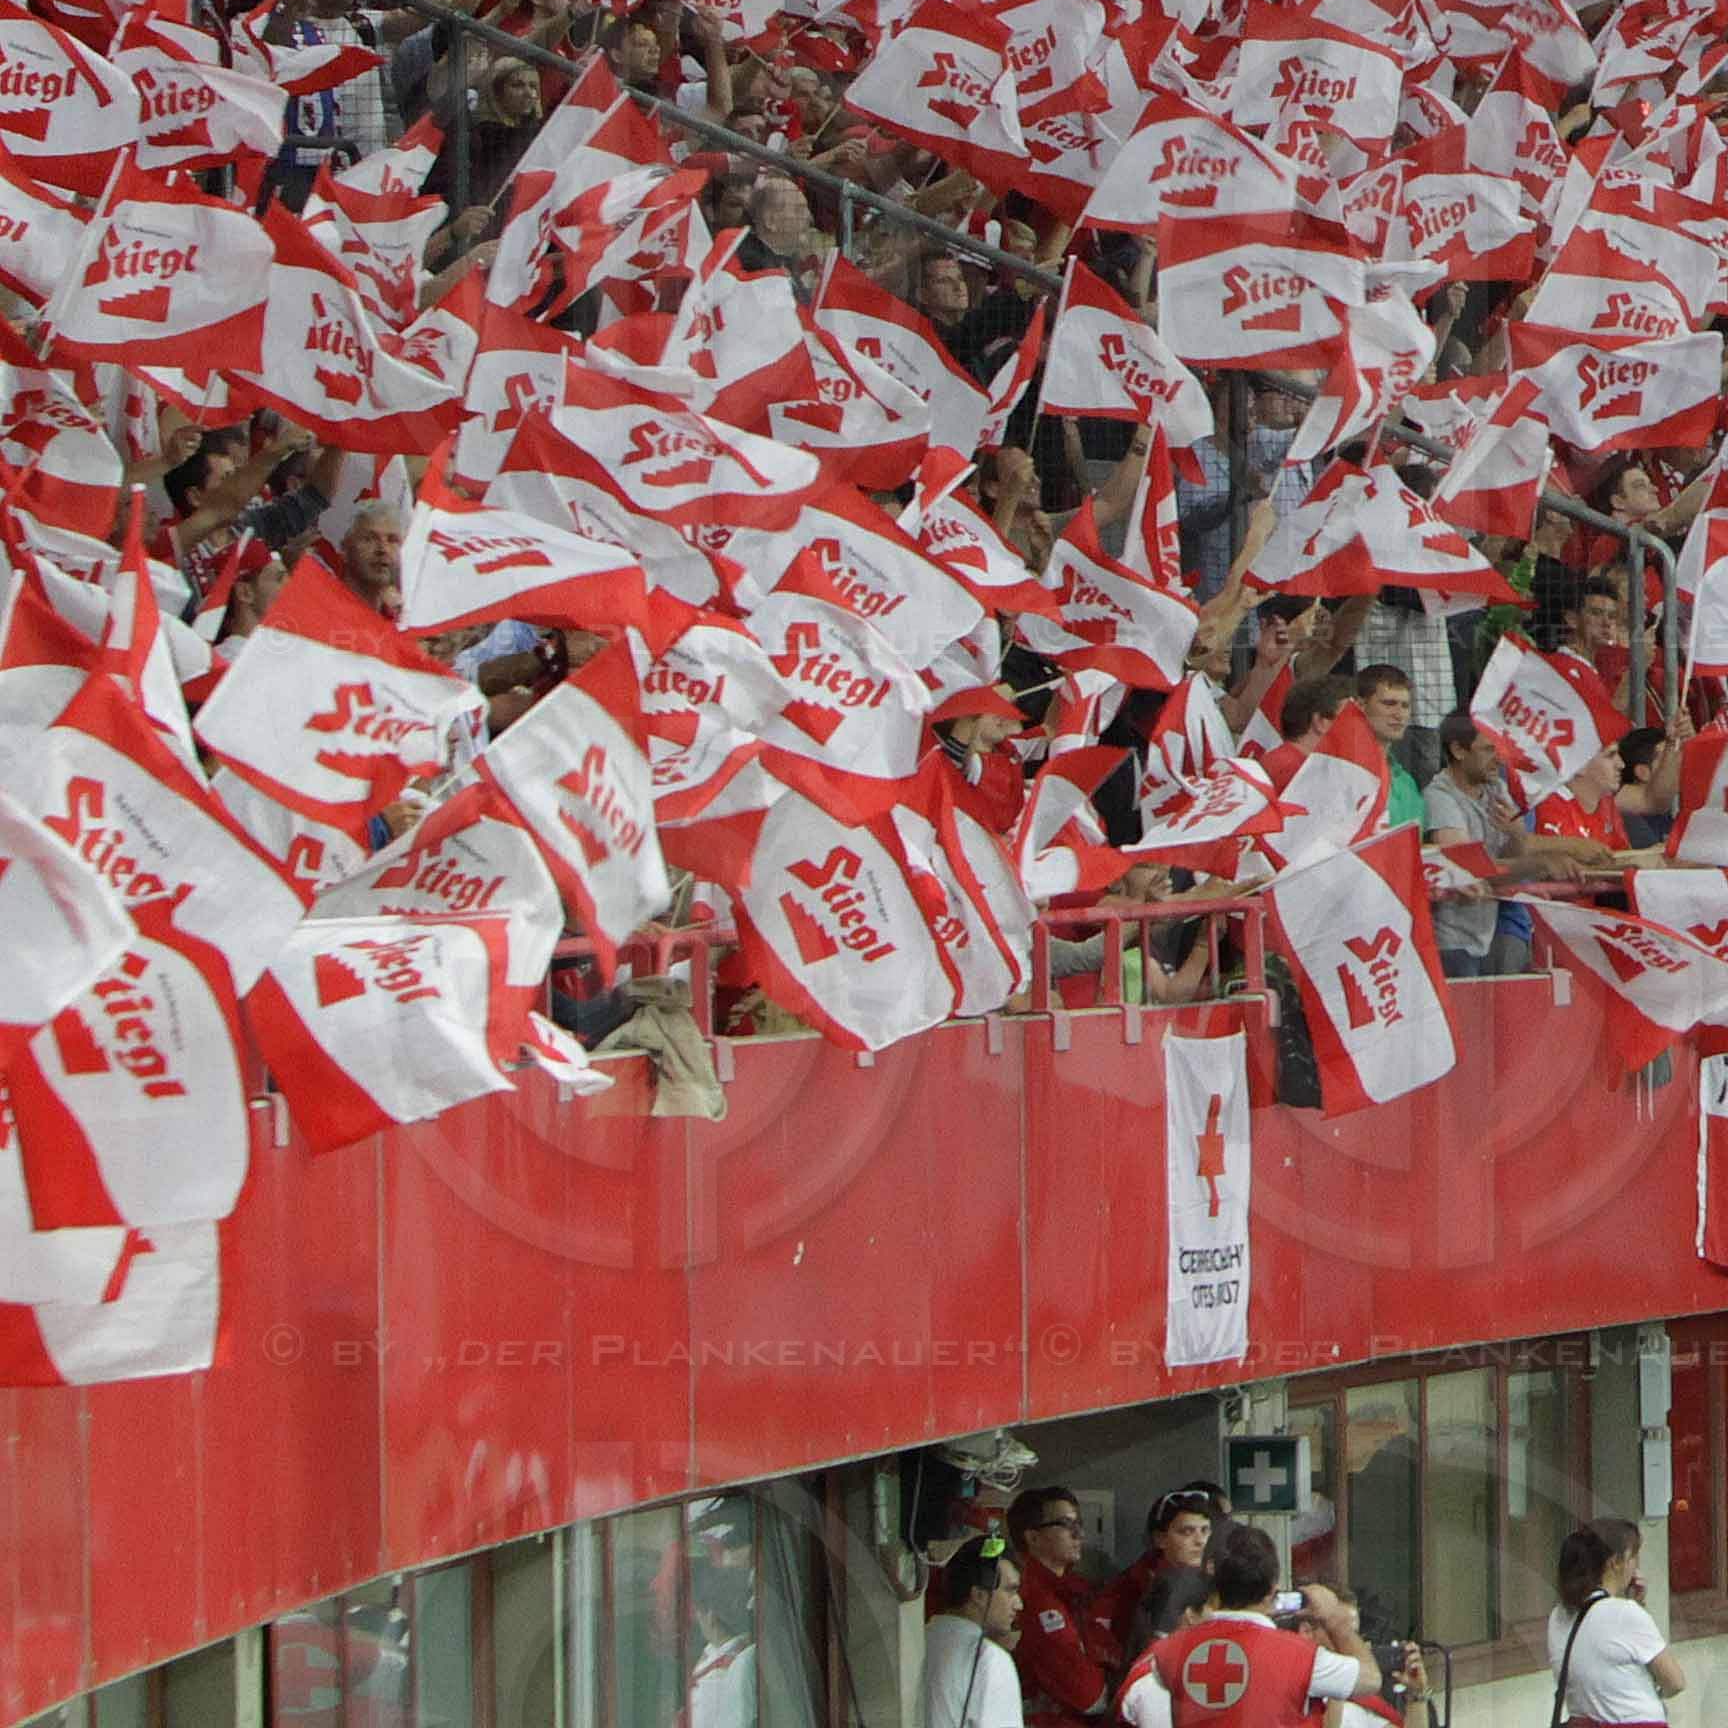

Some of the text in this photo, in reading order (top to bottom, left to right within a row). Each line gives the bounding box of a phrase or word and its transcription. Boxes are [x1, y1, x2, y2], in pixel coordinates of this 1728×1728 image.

[1272, 56, 1358, 103] Stiegl
[771, 622, 891, 710] Stiegl
[788, 845, 896, 964] Stiegl
[1592, 922, 1690, 973] Stiegl
[1344, 926, 1404, 1027] Stiegl
